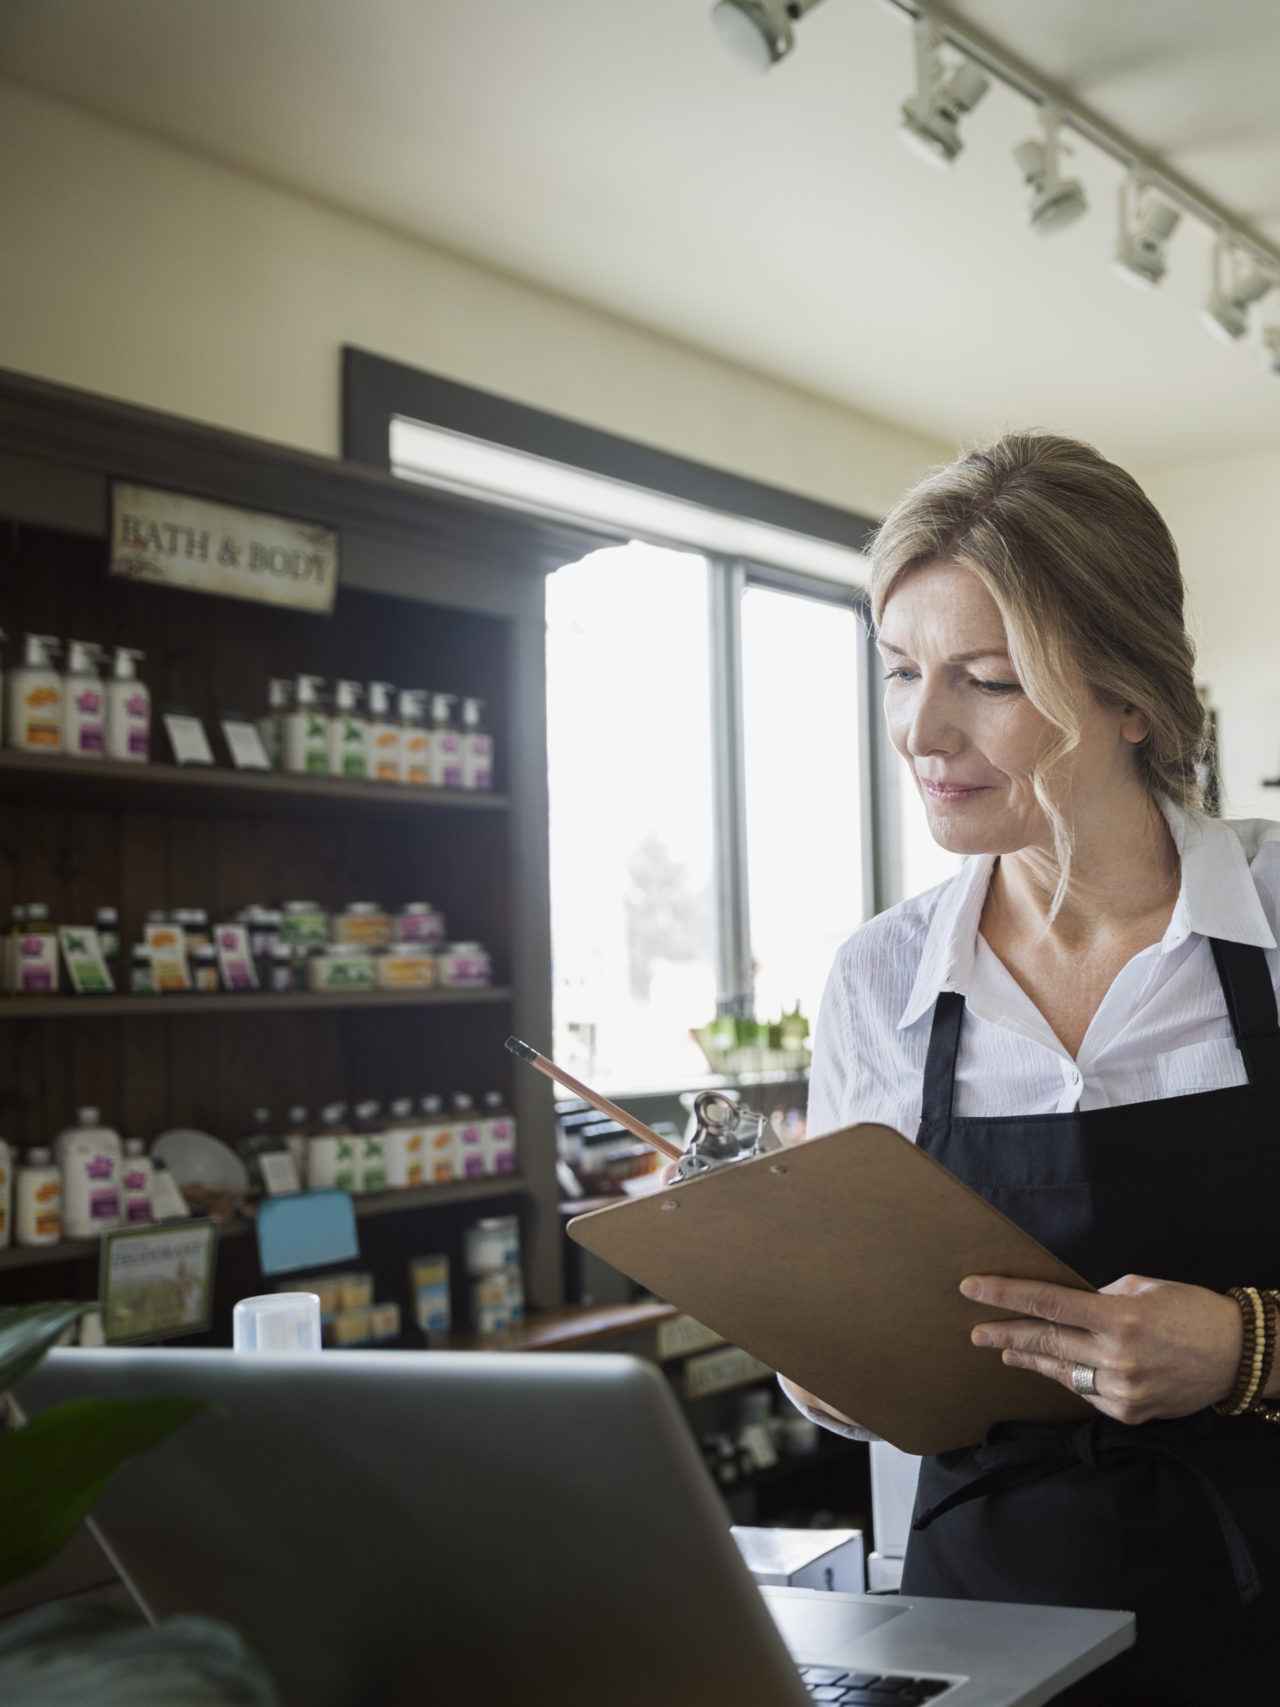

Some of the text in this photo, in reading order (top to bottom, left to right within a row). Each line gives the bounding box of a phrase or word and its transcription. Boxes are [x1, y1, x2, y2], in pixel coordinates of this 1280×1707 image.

[122, 513, 327, 584] BATH & BODY
